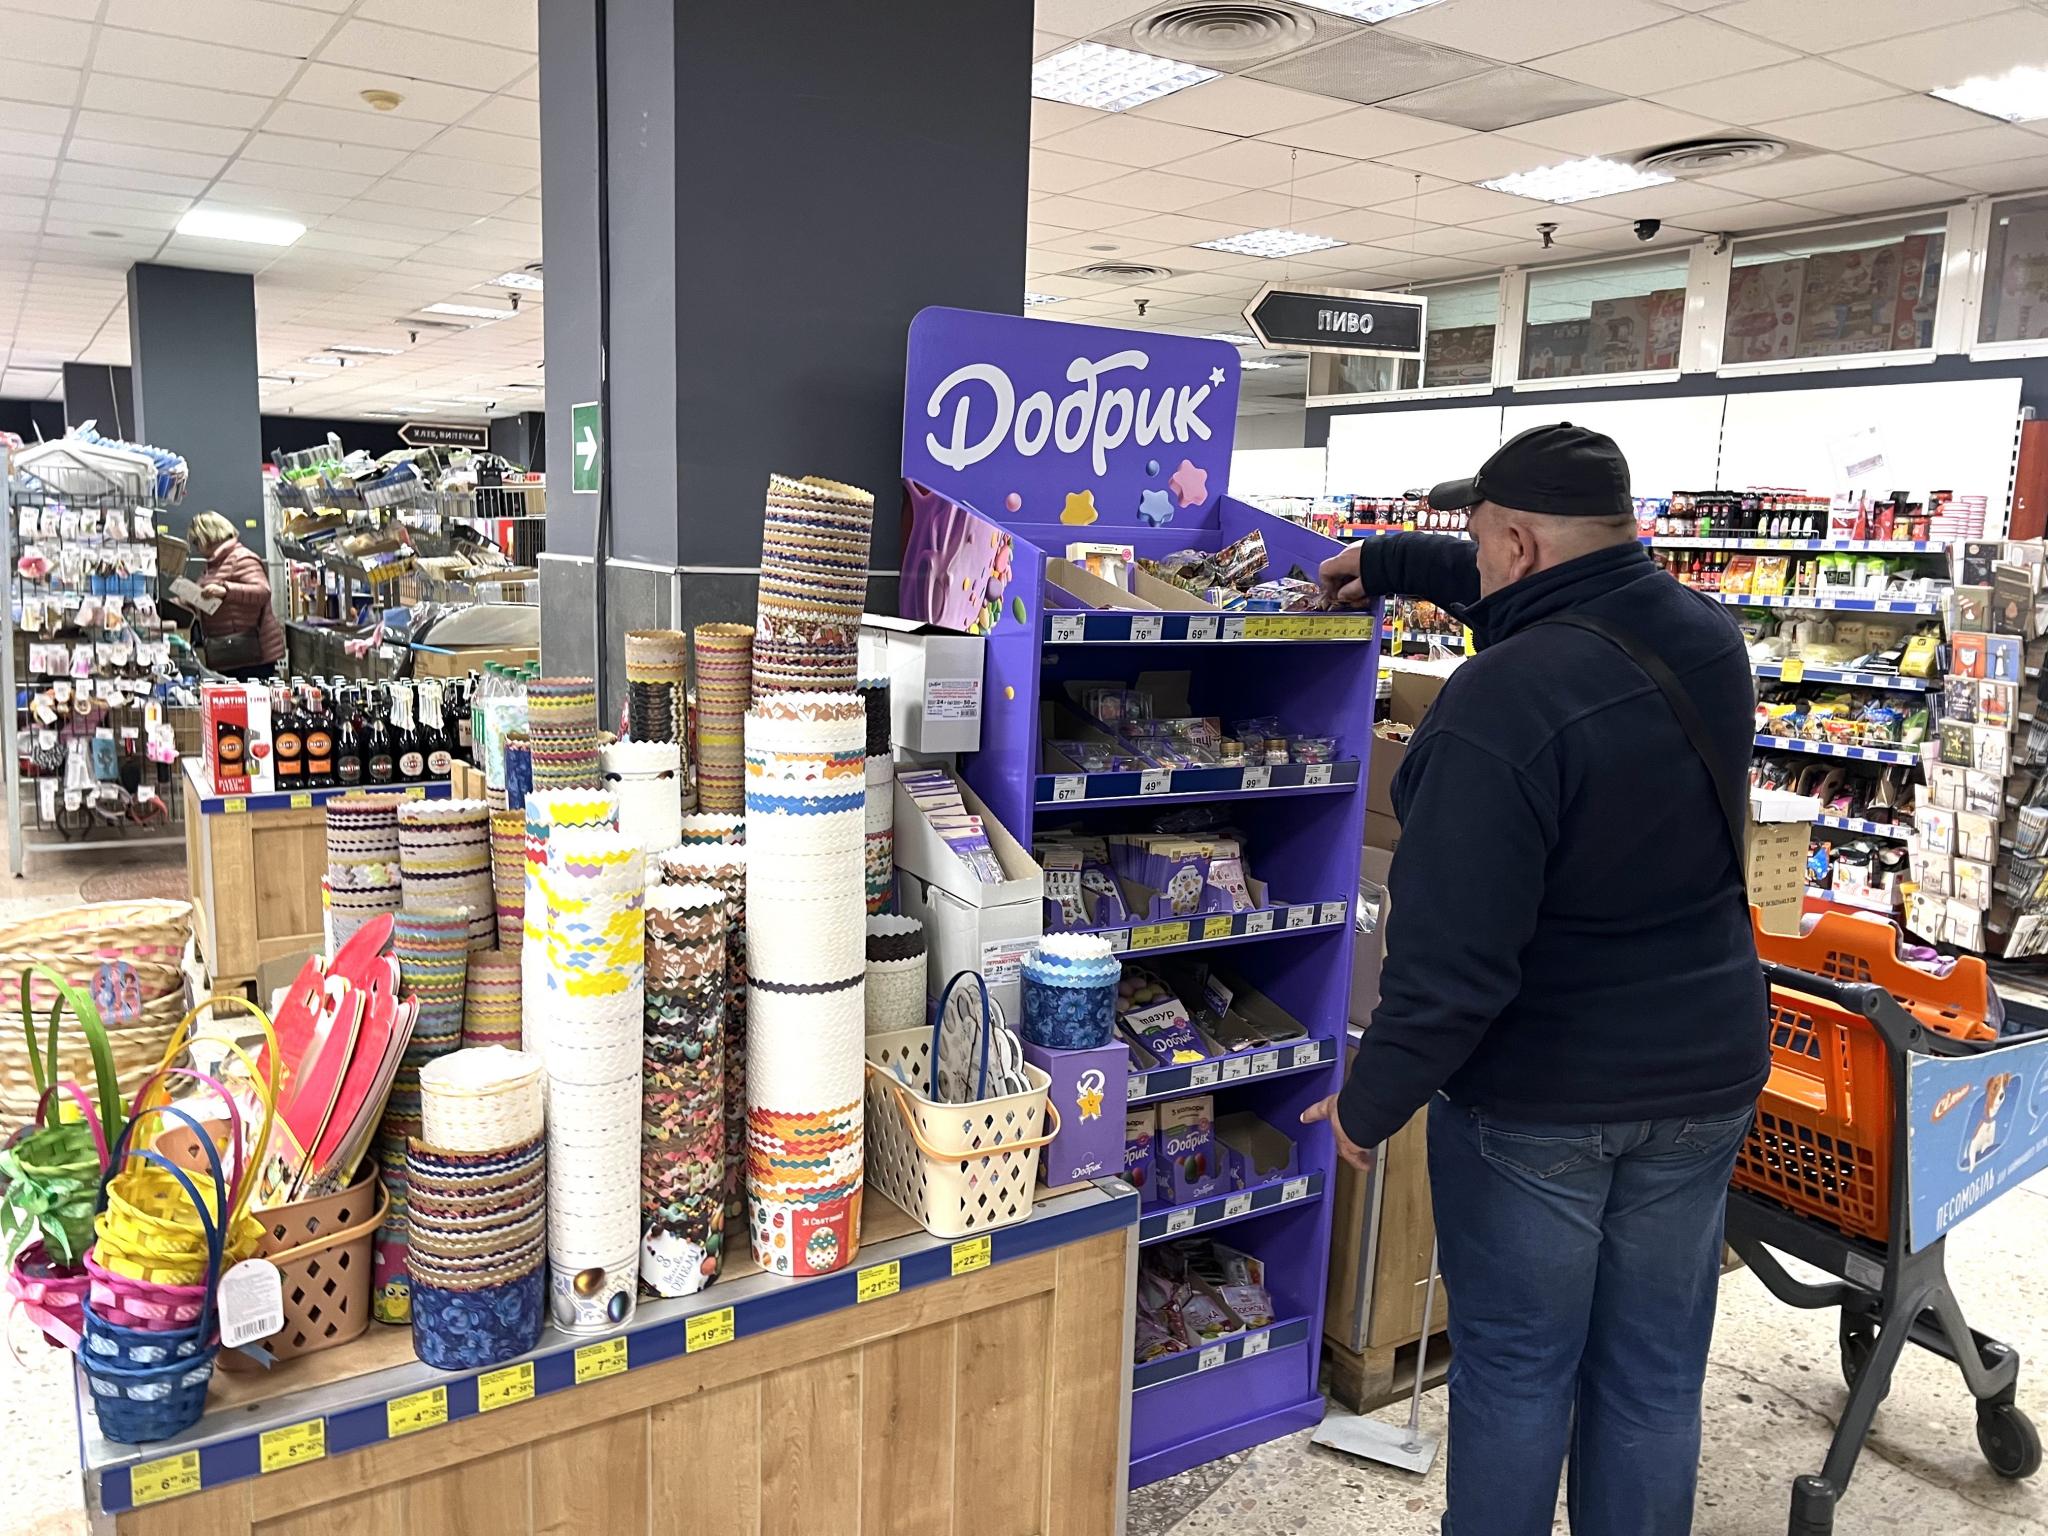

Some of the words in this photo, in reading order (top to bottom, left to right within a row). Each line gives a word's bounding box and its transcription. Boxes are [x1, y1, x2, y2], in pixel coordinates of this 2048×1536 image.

[1317, 309, 1374, 334] ПИВО
[925, 349, 1213, 477] Добрик
[212, 696, 246, 704] MARTINI
[1167, 1131, 1210, 1156] Добрик
[1071, 1161, 1102, 1179] Добрик
[1936, 1167, 1995, 1233] ПЕСОМОБІЛЬ
